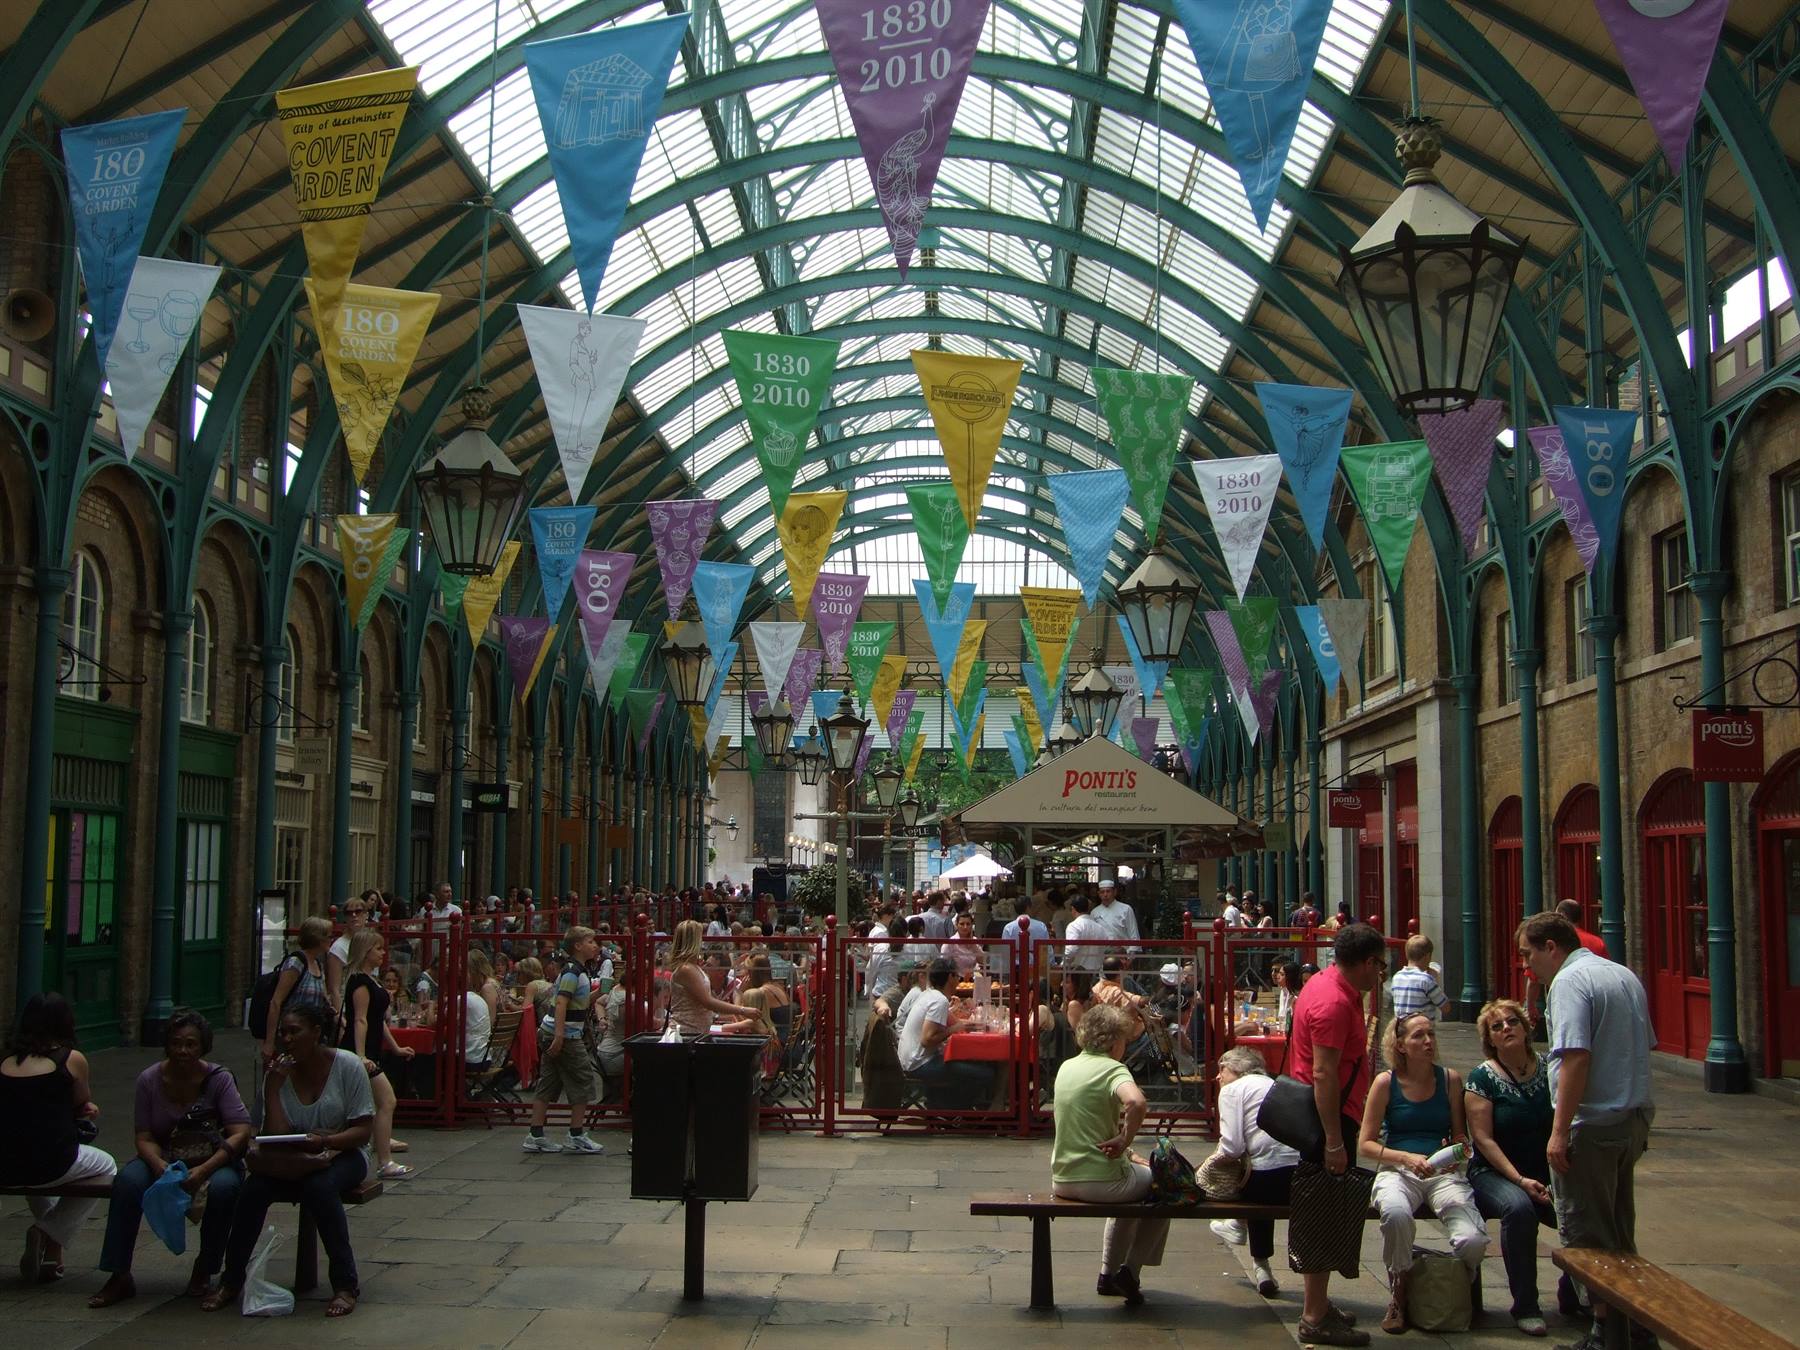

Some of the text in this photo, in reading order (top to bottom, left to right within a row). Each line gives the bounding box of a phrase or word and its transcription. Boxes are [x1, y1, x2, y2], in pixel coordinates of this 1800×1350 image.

[861, 0, 952, 41] 1830
[860, 47, 952, 92] 2010
[318, 119, 329, 130] of
[289, 128, 396, 171] COVENT
[90, 147, 146, 182] 180
[86, 181, 140, 201] COVENT
[84, 196, 138, 216] GARDEN
[342, 308, 399, 336] 180
[340, 336, 398, 351] COVENT
[339, 348, 396, 363] GARDEN
[753, 352, 810, 376] 1830
[752, 383, 810, 408] 2010
[1583, 421, 1615, 497] 180
[1216, 471, 1261, 490] 1830
[1217, 495, 1262, 514] 2010
[548, 521, 576, 538] 180
[586, 560, 612, 613] 180
[820, 583, 853, 597] 1830
[820, 601, 853, 615] 2010
[852, 631, 880, 642] 1830
[852, 645, 880, 657] 2010
[1701, 720, 1753, 742] ponti's
[1062, 768, 1138, 798] PONTI'S
[1095, 791, 1137, 799] restaurant
